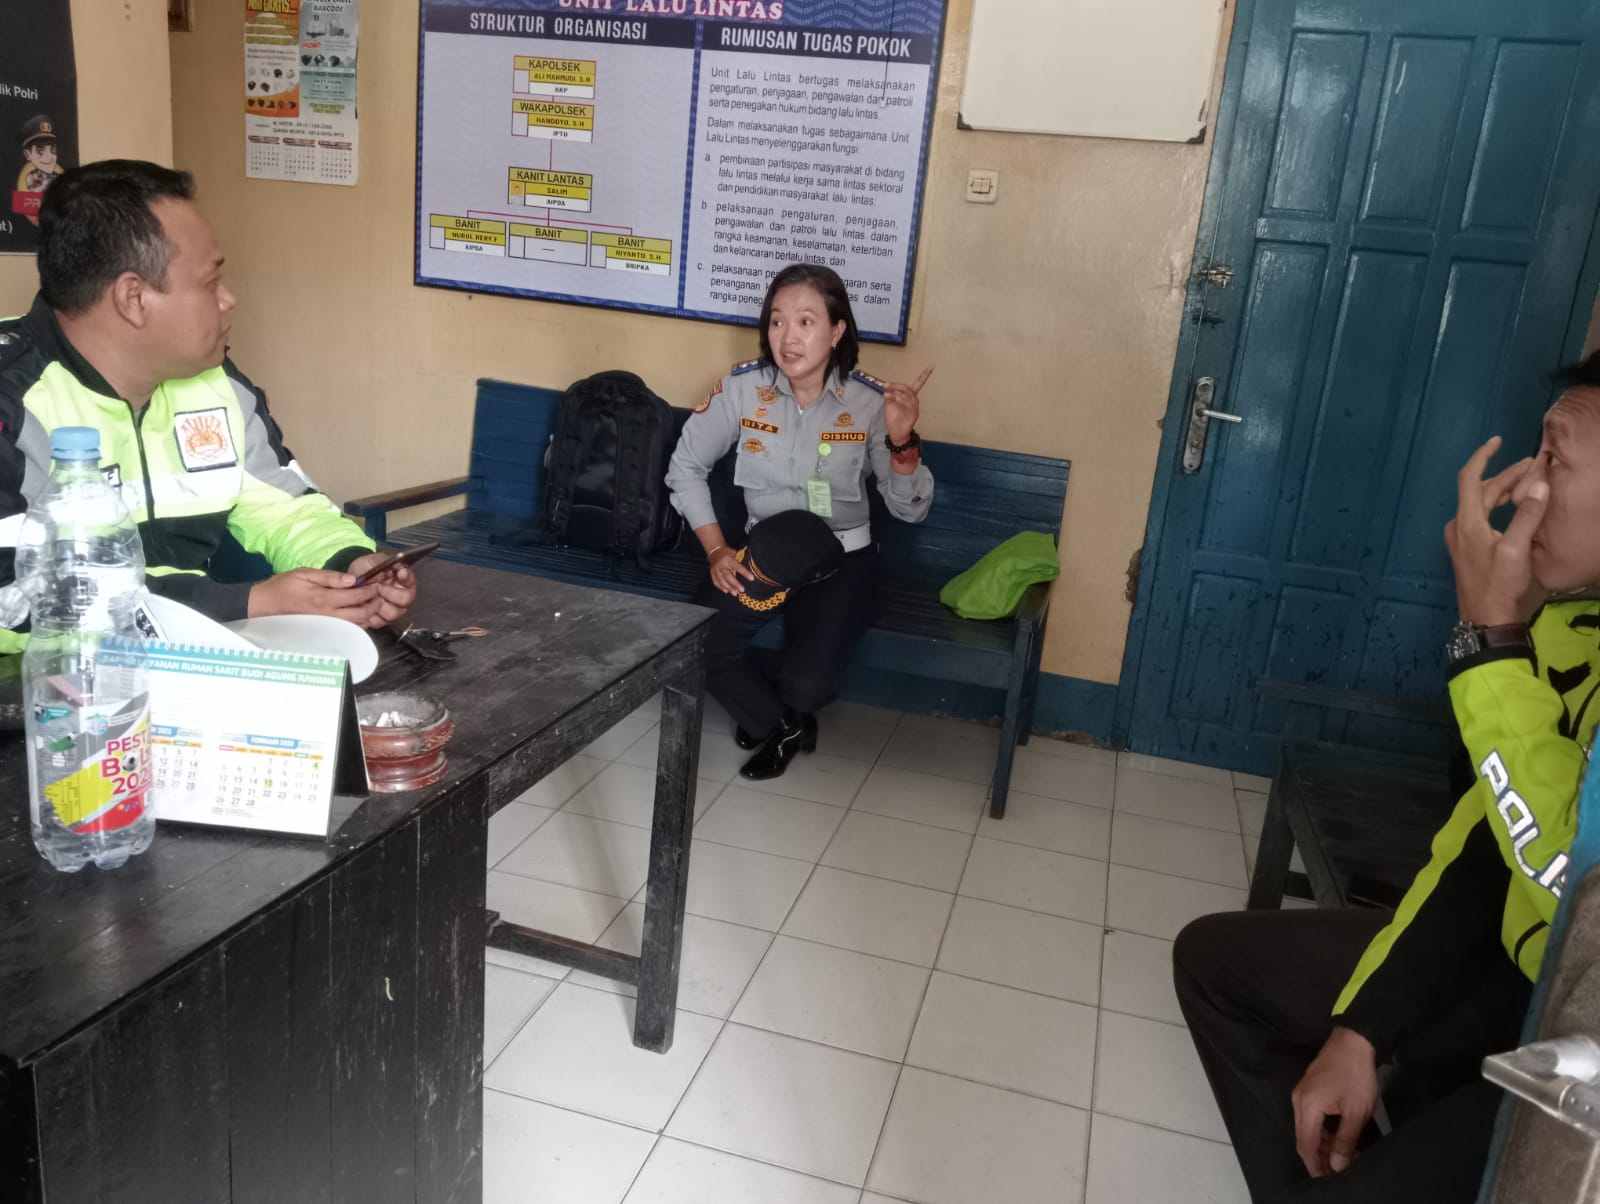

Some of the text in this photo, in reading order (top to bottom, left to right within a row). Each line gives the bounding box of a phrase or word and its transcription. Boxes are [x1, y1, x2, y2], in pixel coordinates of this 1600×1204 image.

[626, 0, 687, 14] LALU
[693, 0, 783, 20] LINTAS
[470, 12, 647, 40] STRUKTUR ORGANISASI
[721, 27, 912, 57] RUMUSAN TUGAS POKOK
[528, 59, 581, 72] KAPOLSEK
[711, 67, 915, 91] Unit Lalu Lintas bertugas melaksanakan
[14, 85, 39, 101] Polri
[519, 103, 586, 116] WAKAPOLSEK
[731, 99, 776, 112] penegakan
[778, 102, 807, 113] hukum
[808, 105, 837, 119] bidang
[706, 130, 724, 142] Lalu
[725, 132, 750, 145] Lintas
[707, 116, 910, 143] Dalam melaksanakan tugas sebagaimana Unit
[719, 154, 765, 167] pembinaan
[768, 159, 810, 171] partisipasi
[812, 162, 863, 175] masyarakat
[865, 166, 872, 177] di
[875, 167, 905, 181] bidang
[516, 170, 585, 186] KANIT LANTAS
[736, 169, 758, 181] lintas
[816, 177, 840, 188] sama
[843, 178, 866, 191] lintas
[869, 181, 904, 194] sektoral
[716, 202, 774, 217] pelaksanaan
[455, 218, 481, 230] BANIT
[715, 217, 764, 229] pengawalan
[769, 222, 785, 232] dan
[842, 229, 865, 240] lintas
[870, 232, 897, 244] dalam
[535, 227, 563, 239] BANIT
[714, 231, 742, 242] rangka
[617, 236, 646, 248] BANIT
[729, 246, 774, 258] kelancaran
[710, 277, 761, 290] penanganan
[711, 263, 763, 277] pelaksanaan
[870, 281, 893, 292] serta
[709, 291, 738, 303] rangka
[863, 294, 890, 305] dalam
